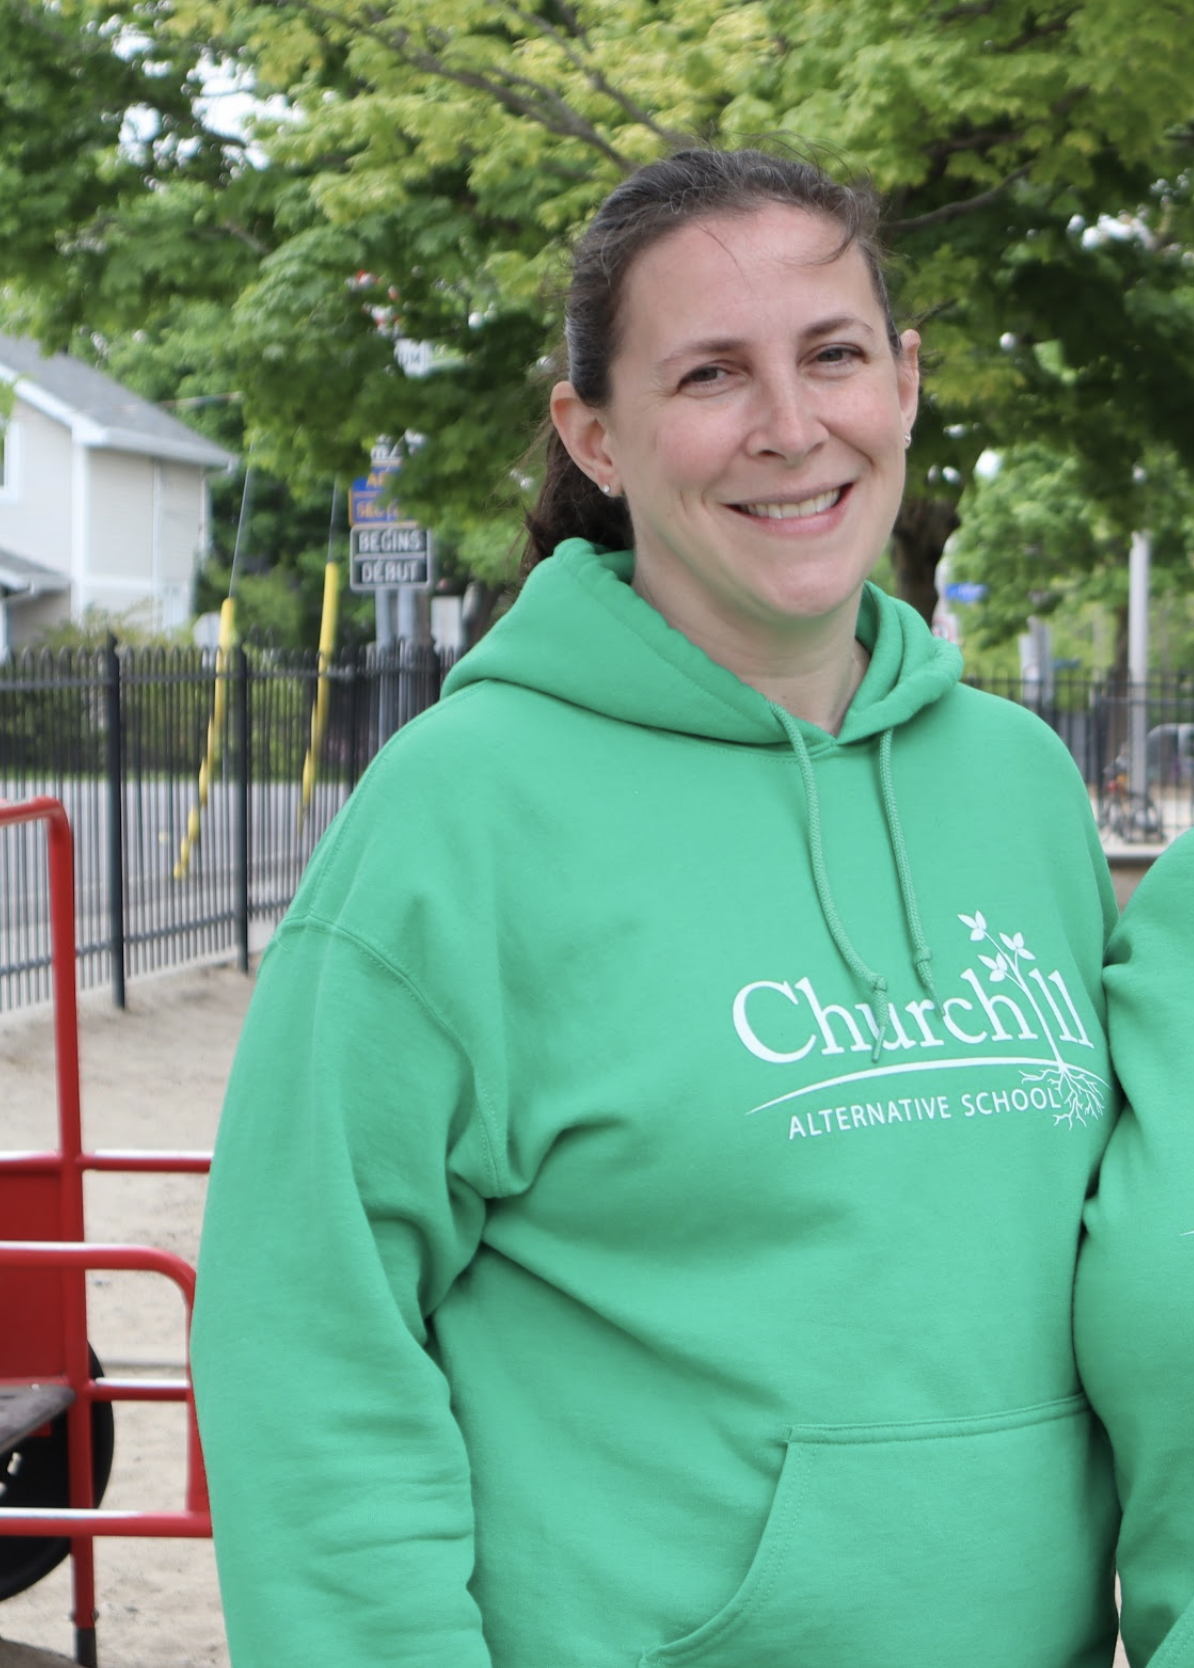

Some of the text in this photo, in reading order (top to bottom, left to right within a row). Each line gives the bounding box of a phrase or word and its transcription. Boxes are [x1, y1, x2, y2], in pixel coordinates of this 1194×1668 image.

[358, 530, 421, 552] BEGINS
[789, 1087, 1061, 1139] ALTERNATIVE SCHOOL
